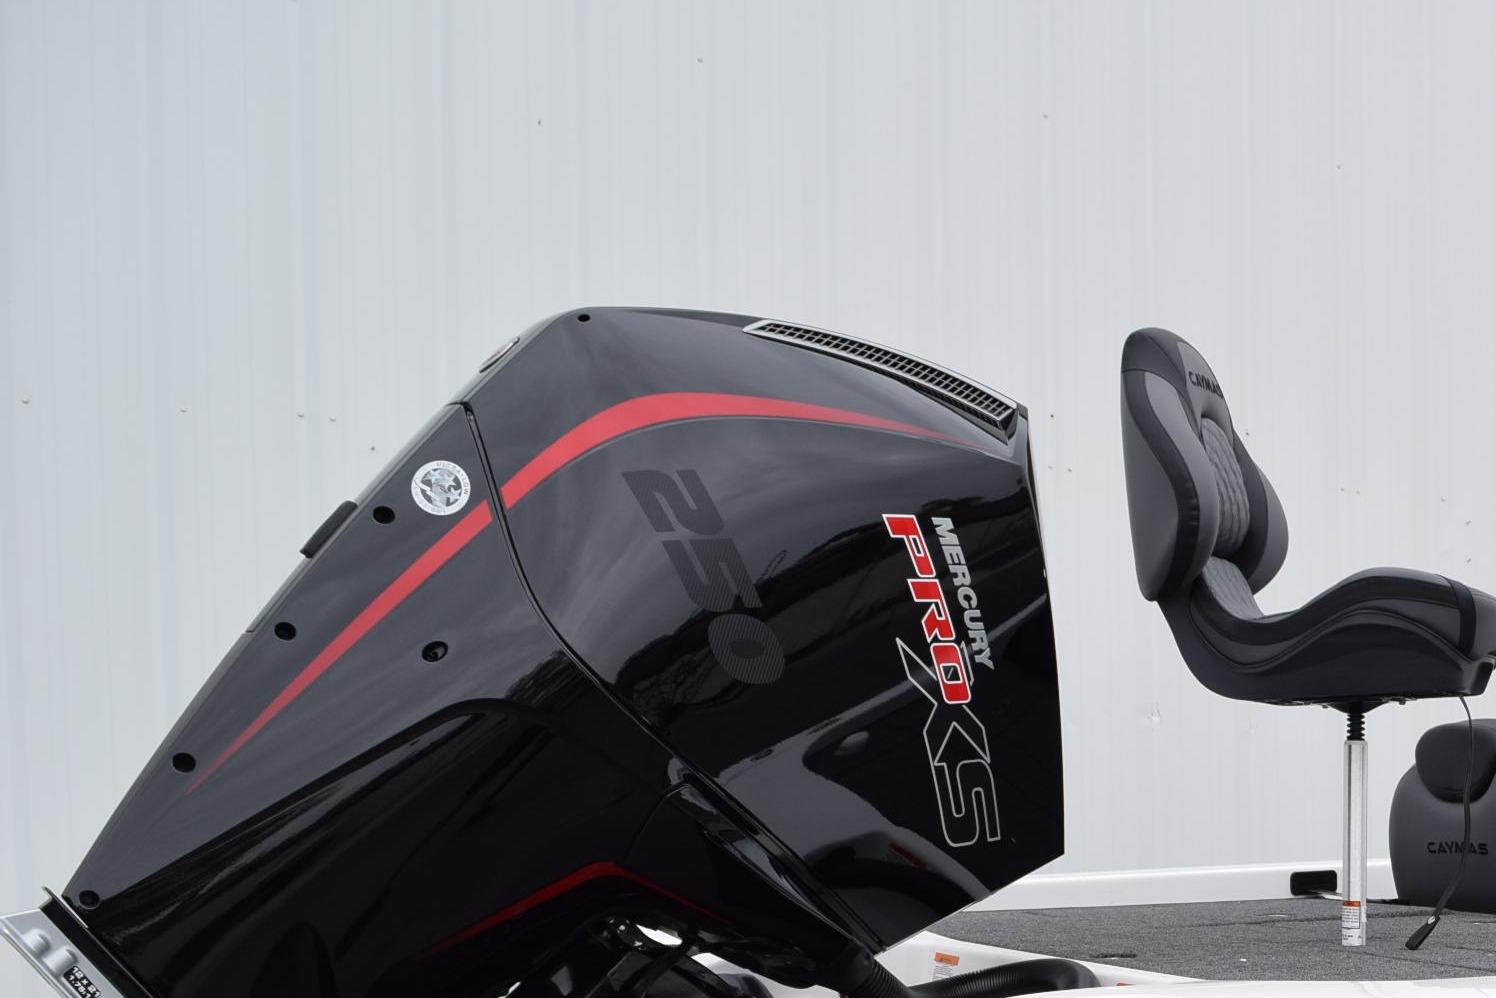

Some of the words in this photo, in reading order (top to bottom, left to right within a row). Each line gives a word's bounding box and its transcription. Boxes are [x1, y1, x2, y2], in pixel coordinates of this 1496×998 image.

[621, 469, 786, 684] 250
[881, 514, 972, 704] PRO
[931, 517, 994, 670] MERCURY
[896, 637, 1001, 847] XS
